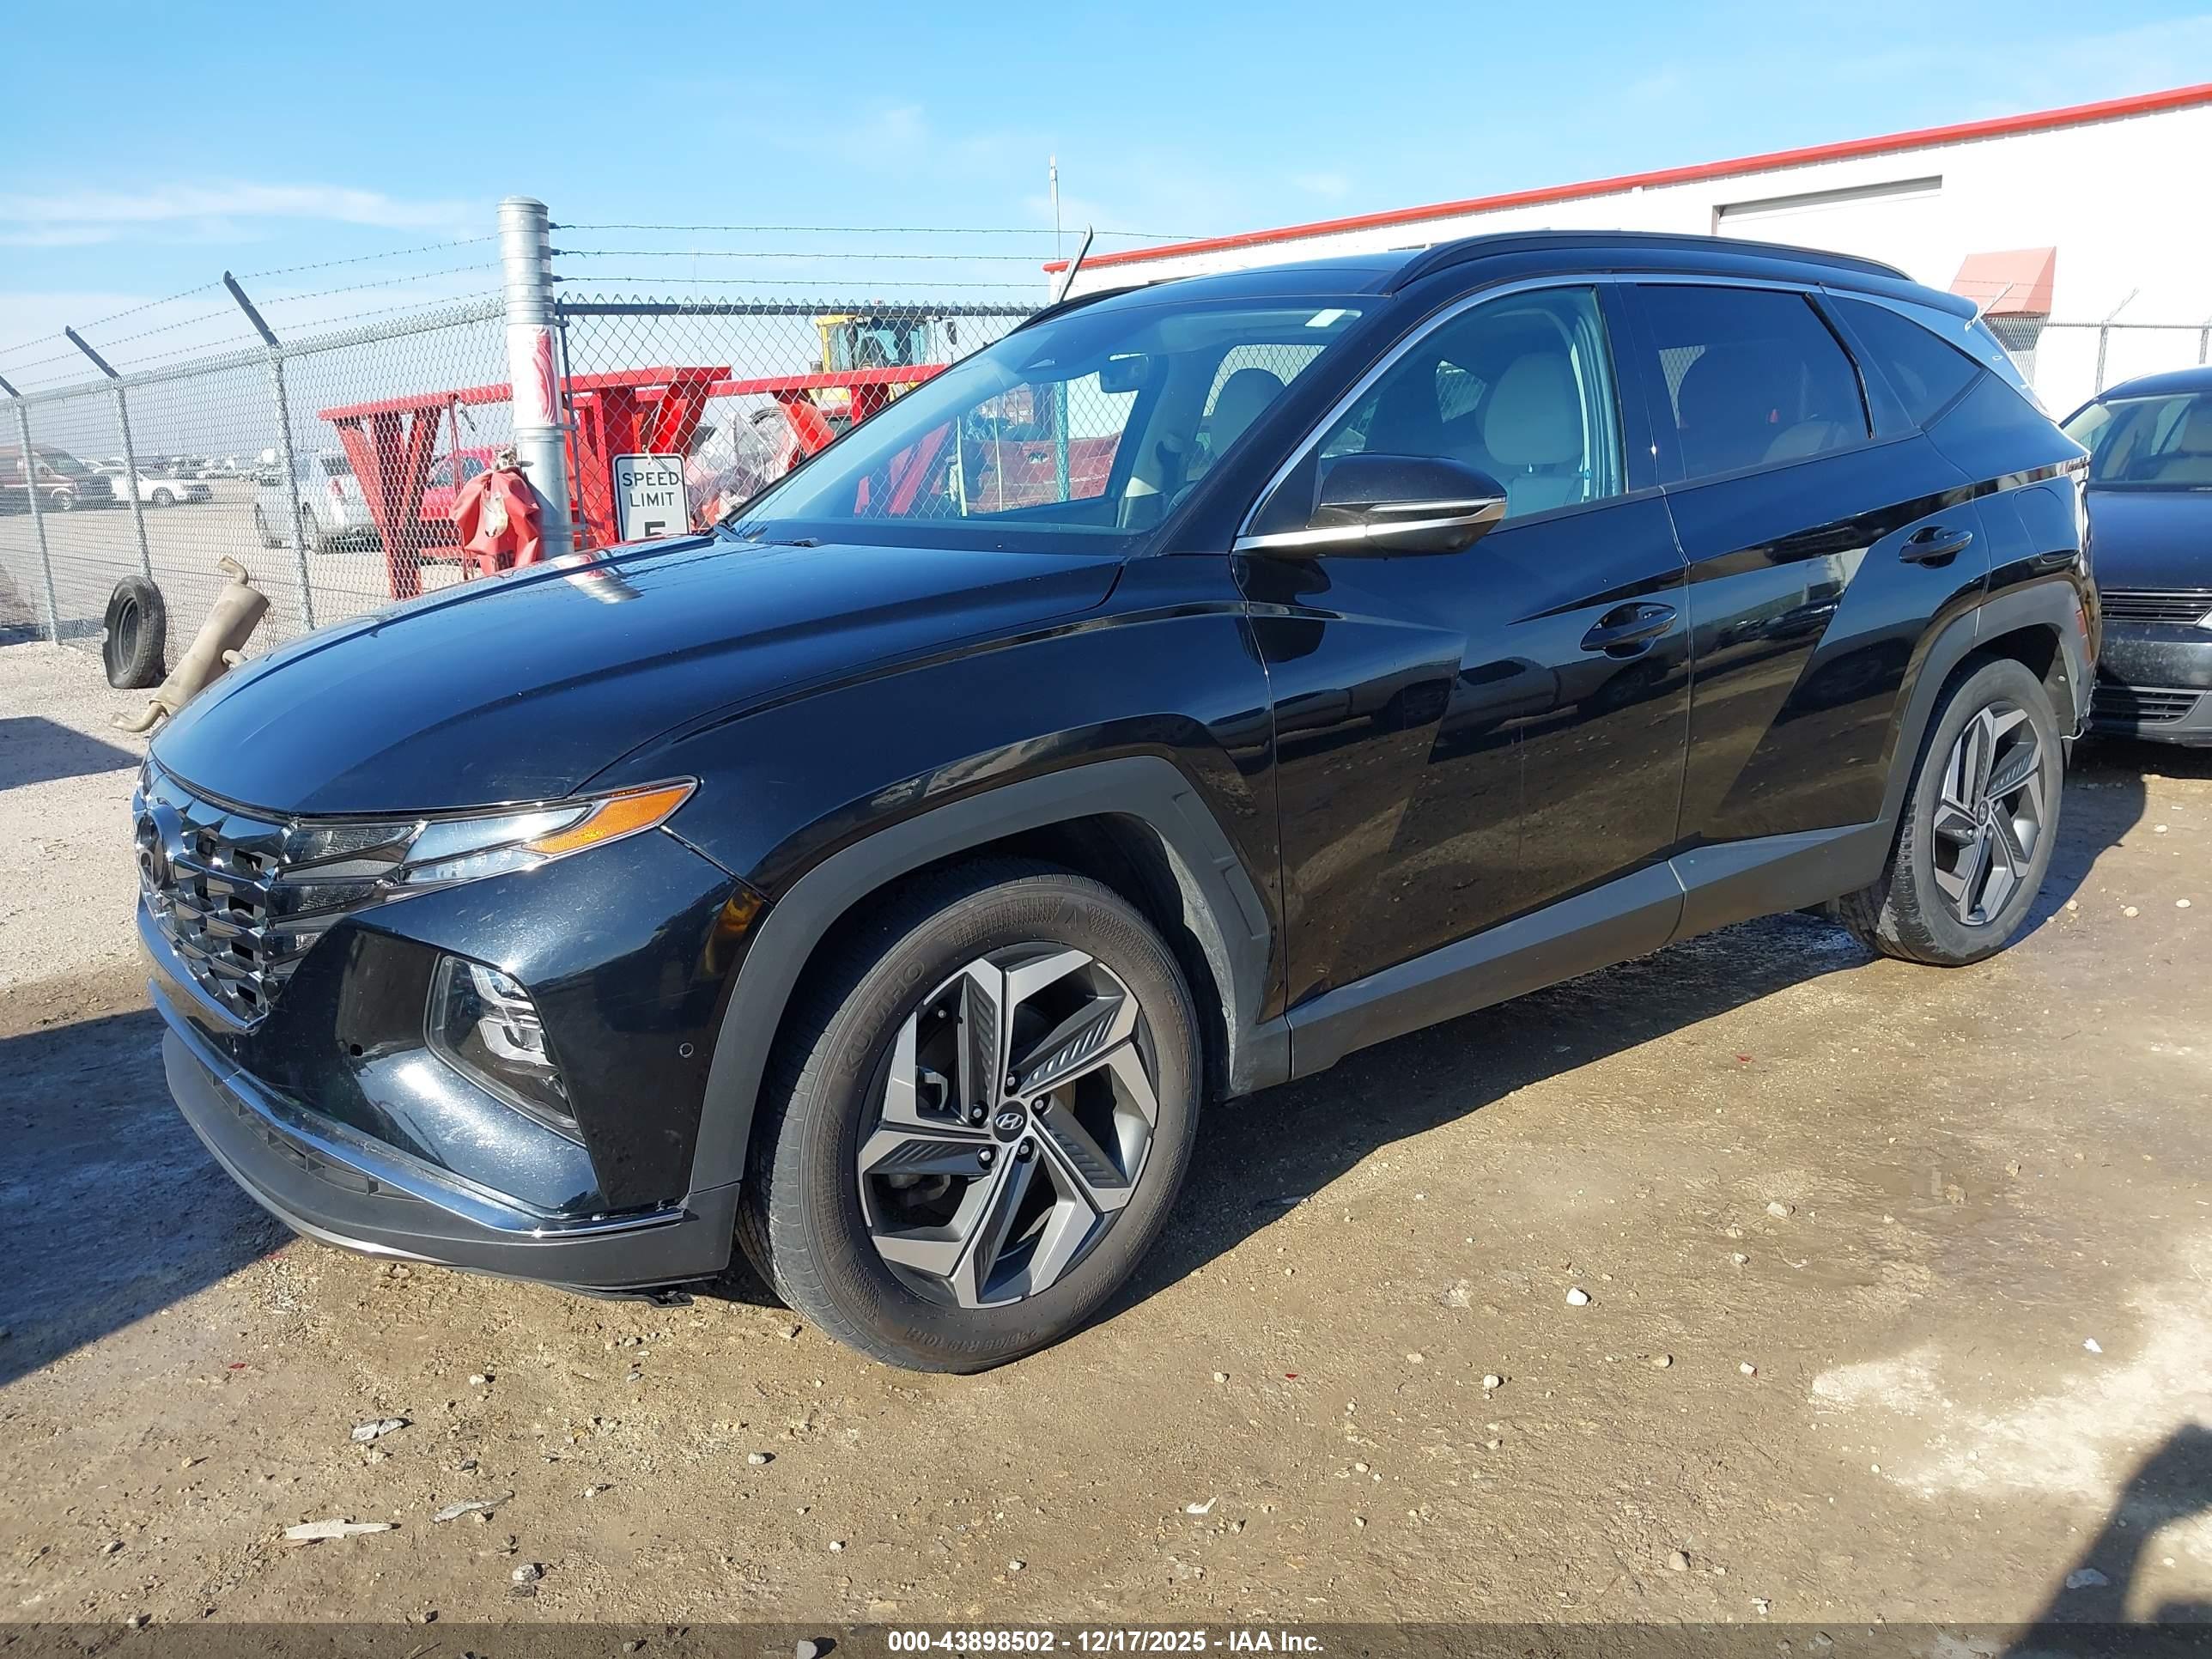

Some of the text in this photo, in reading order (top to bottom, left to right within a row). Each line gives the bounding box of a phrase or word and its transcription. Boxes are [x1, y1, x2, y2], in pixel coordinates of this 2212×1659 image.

[622, 472, 679, 487] SPEED
[629, 492, 675, 507] LIMIT
[841, 960, 925, 1079] KUMHO
